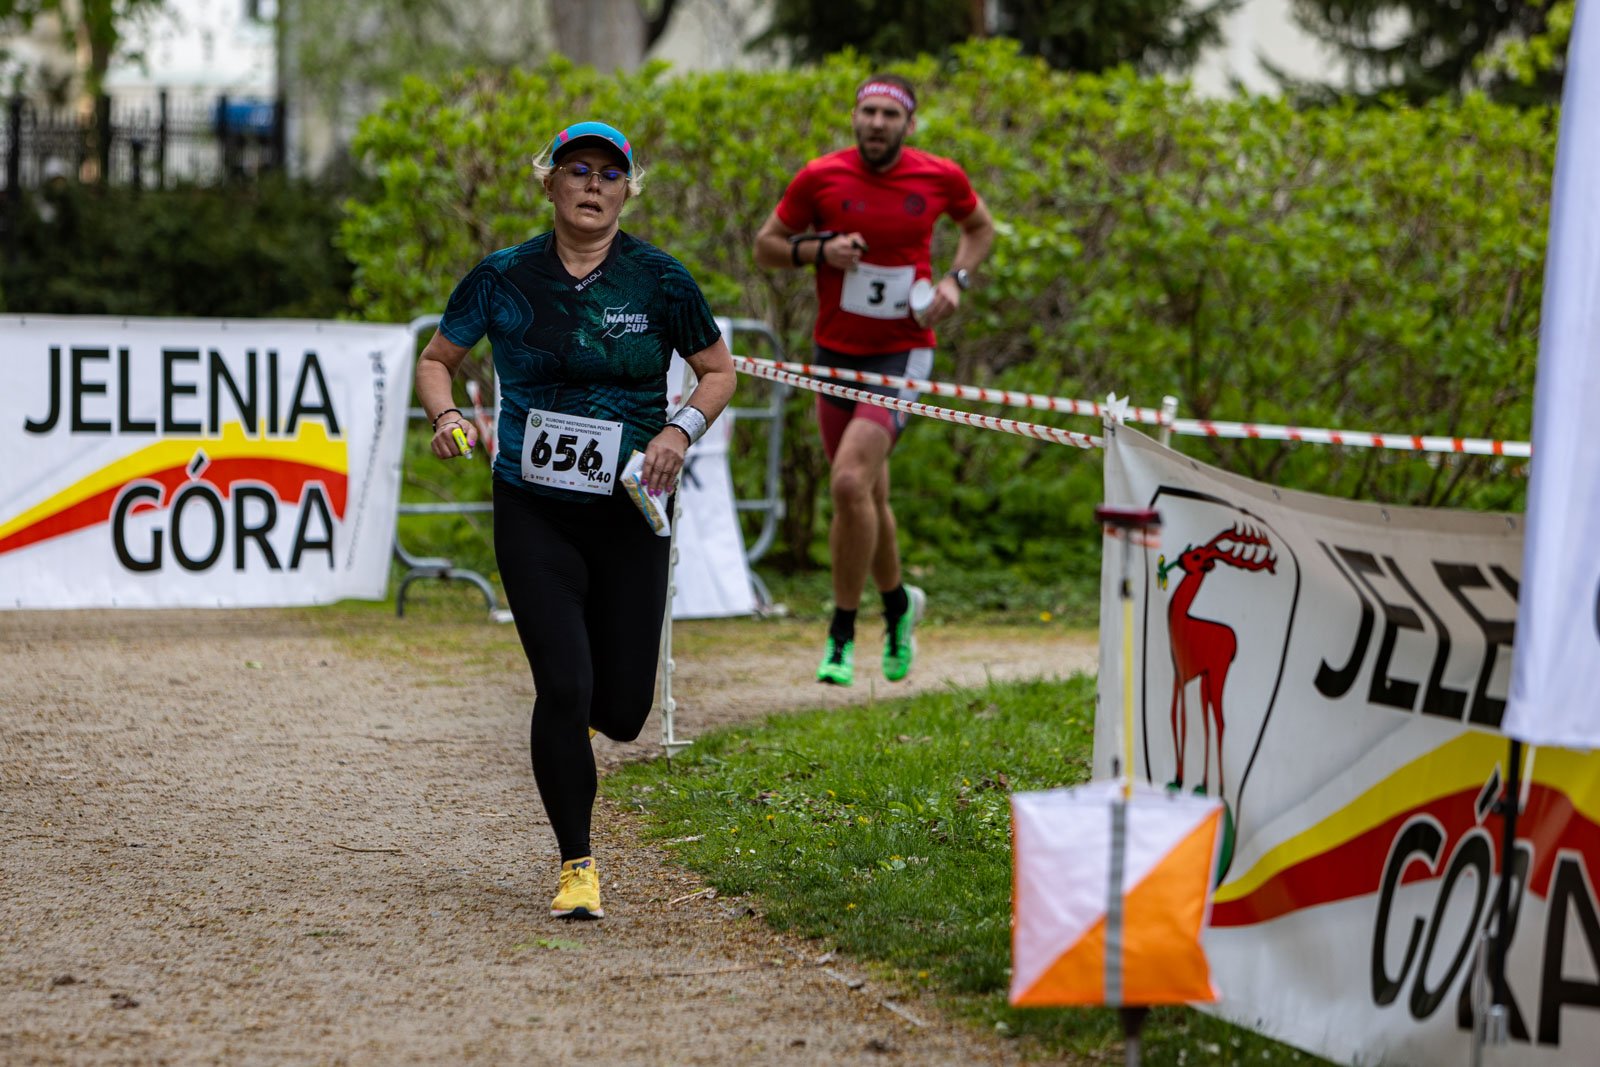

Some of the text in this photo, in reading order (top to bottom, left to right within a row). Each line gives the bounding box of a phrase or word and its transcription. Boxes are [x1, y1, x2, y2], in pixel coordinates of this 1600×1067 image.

[868, 281, 886, 304] 3
[606, 313, 649, 324] WAWEL
[625, 323, 649, 333] CUP
[24, 345, 341, 436] JELENIA
[545, 417, 565, 425] KLUBOWE
[566, 420, 597, 429] MISTRZOSTWA
[575, 427, 602, 436] SPRINTERSKI
[531, 430, 603, 477] 656
[587, 470, 611, 483] K40
[112, 451, 335, 572] GÓRA
